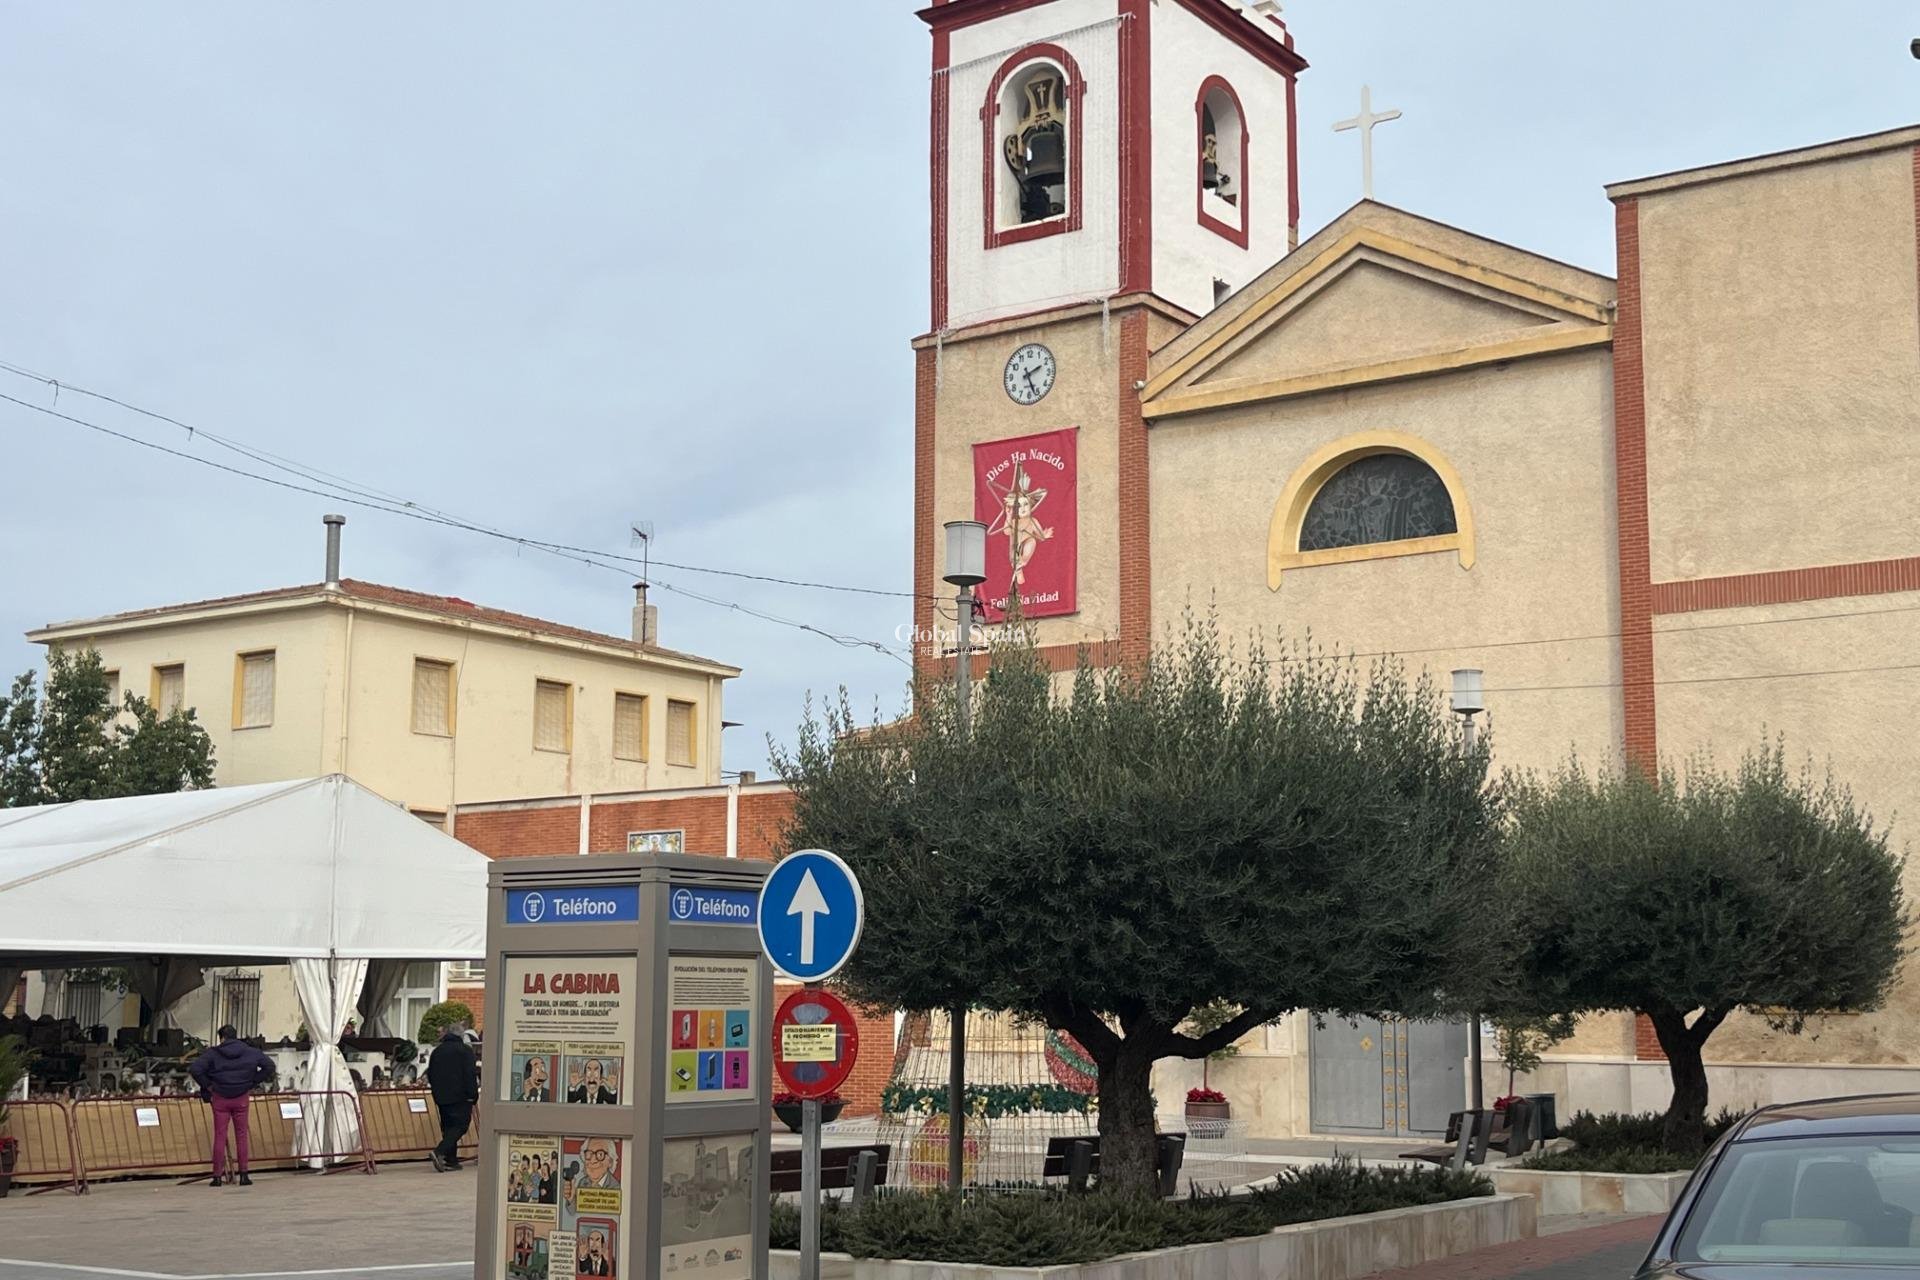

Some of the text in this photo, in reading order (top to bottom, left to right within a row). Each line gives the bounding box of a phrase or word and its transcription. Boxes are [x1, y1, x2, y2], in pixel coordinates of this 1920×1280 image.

[986, 448, 1065, 482] Dios Ha Nacido
[990, 597, 1012, 609] Feli
[553, 898, 617, 916] Teléfono
[694, 897, 750, 918] Teléfono
[523, 973, 620, 994] LA CABINA
